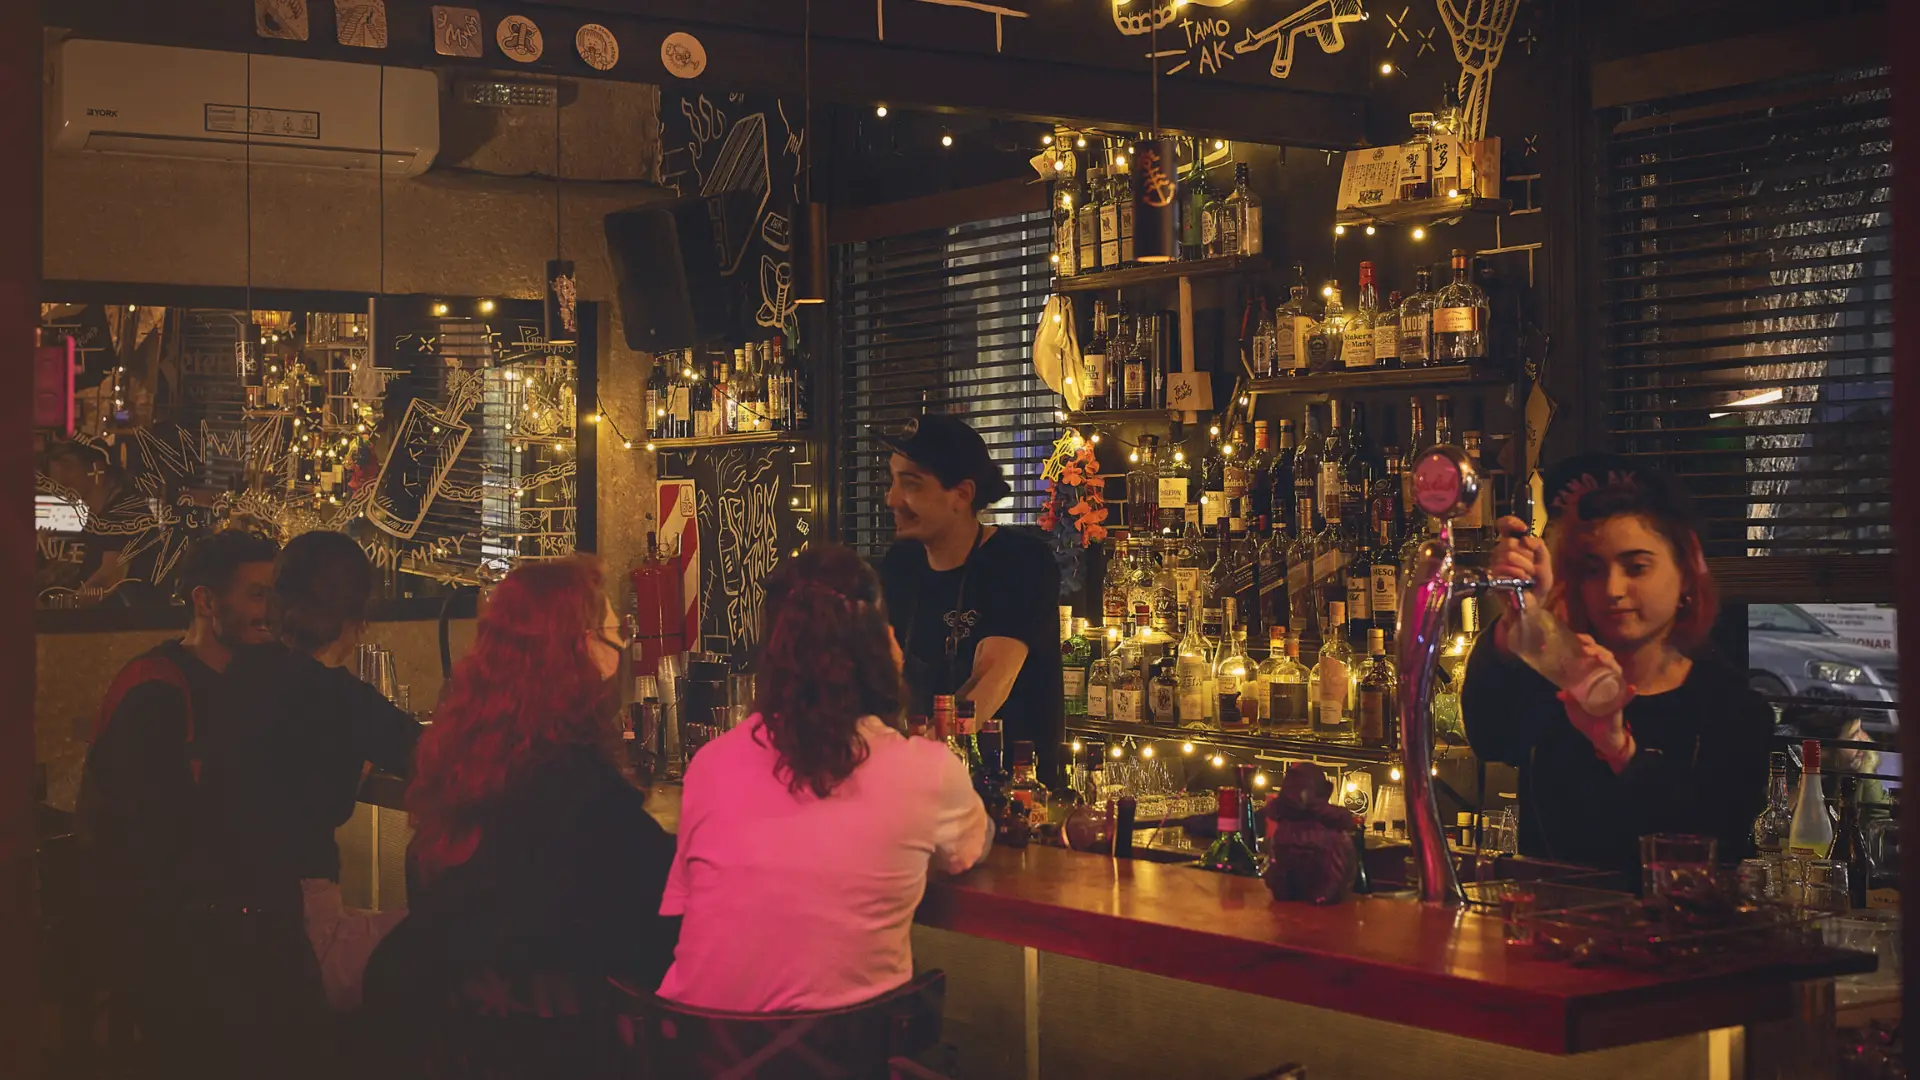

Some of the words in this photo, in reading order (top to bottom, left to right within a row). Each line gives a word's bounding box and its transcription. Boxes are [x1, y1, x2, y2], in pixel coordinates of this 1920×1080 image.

[1178, 17, 1230, 48] TAMO
[1199, 40, 1234, 74] AK
[95, 108, 118, 117] YORK
[1402, 315, 1424, 332] KNOB
[1344, 333, 1373, 341] Maker's
[1157, 601, 1169, 610] XV
